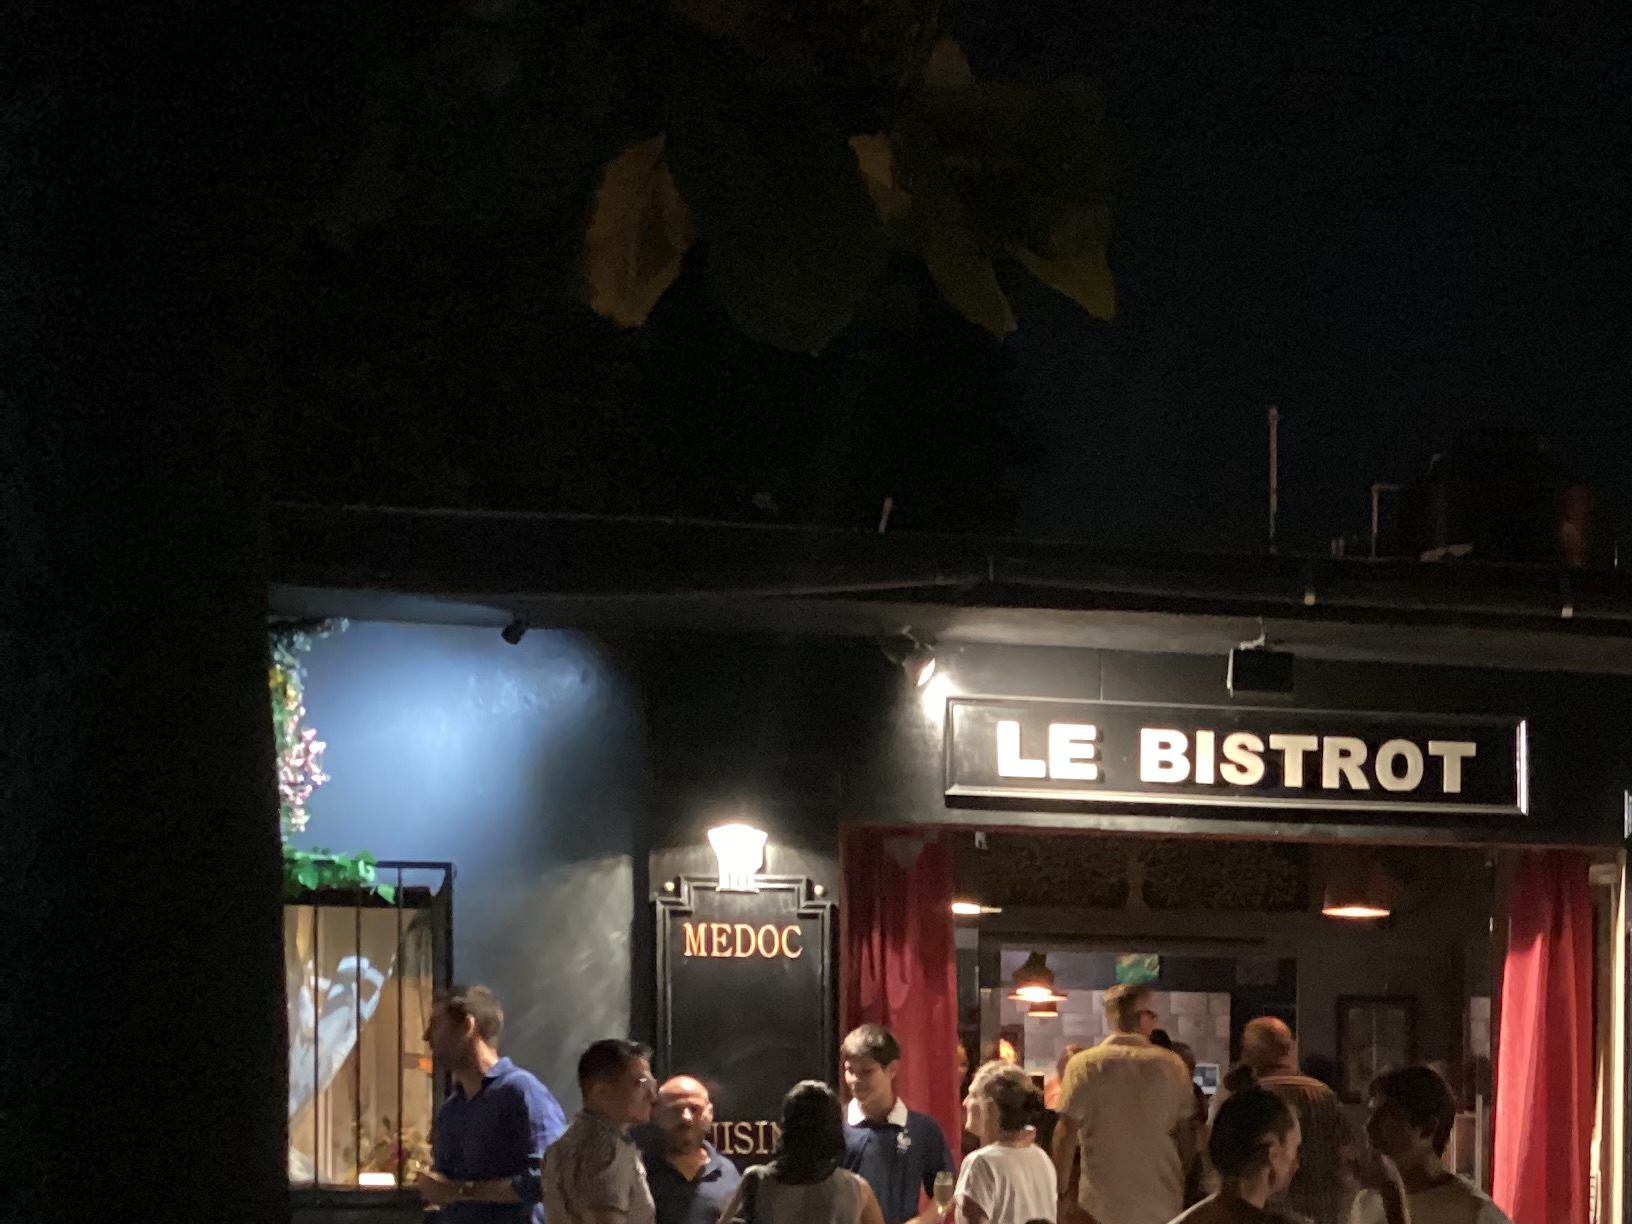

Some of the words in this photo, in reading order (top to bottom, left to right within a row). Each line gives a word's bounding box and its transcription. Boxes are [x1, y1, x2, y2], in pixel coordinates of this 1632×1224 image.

[996, 720, 1098, 780] LE
[1140, 728, 1477, 793] BISTROT
[683, 922, 803, 959] MEDOC
[712, 1120, 784, 1155] ISIN
